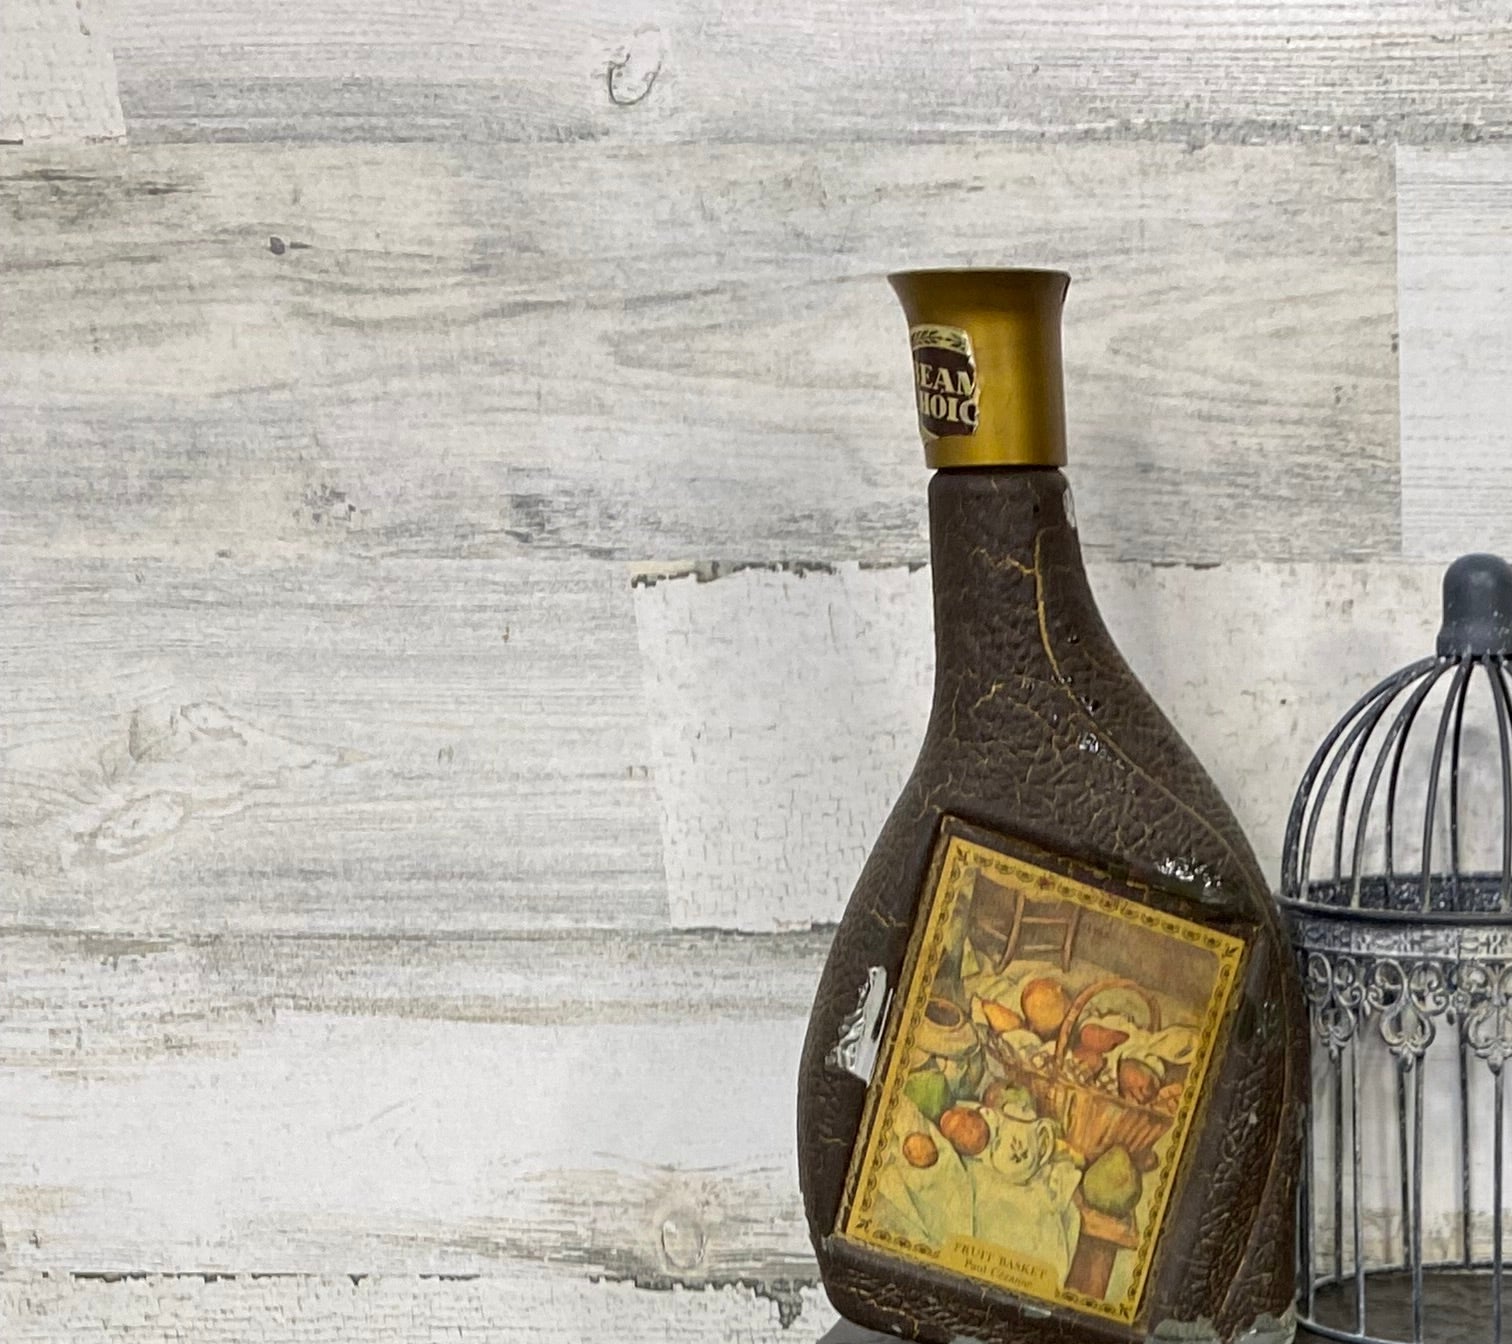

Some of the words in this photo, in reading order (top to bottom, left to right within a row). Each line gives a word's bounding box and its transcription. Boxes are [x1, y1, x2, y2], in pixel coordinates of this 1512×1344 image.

[916, 361, 976, 397] EAM
[953, 1242, 991, 1262] FRUIT
[999, 1256, 1047, 1279] BASKET
